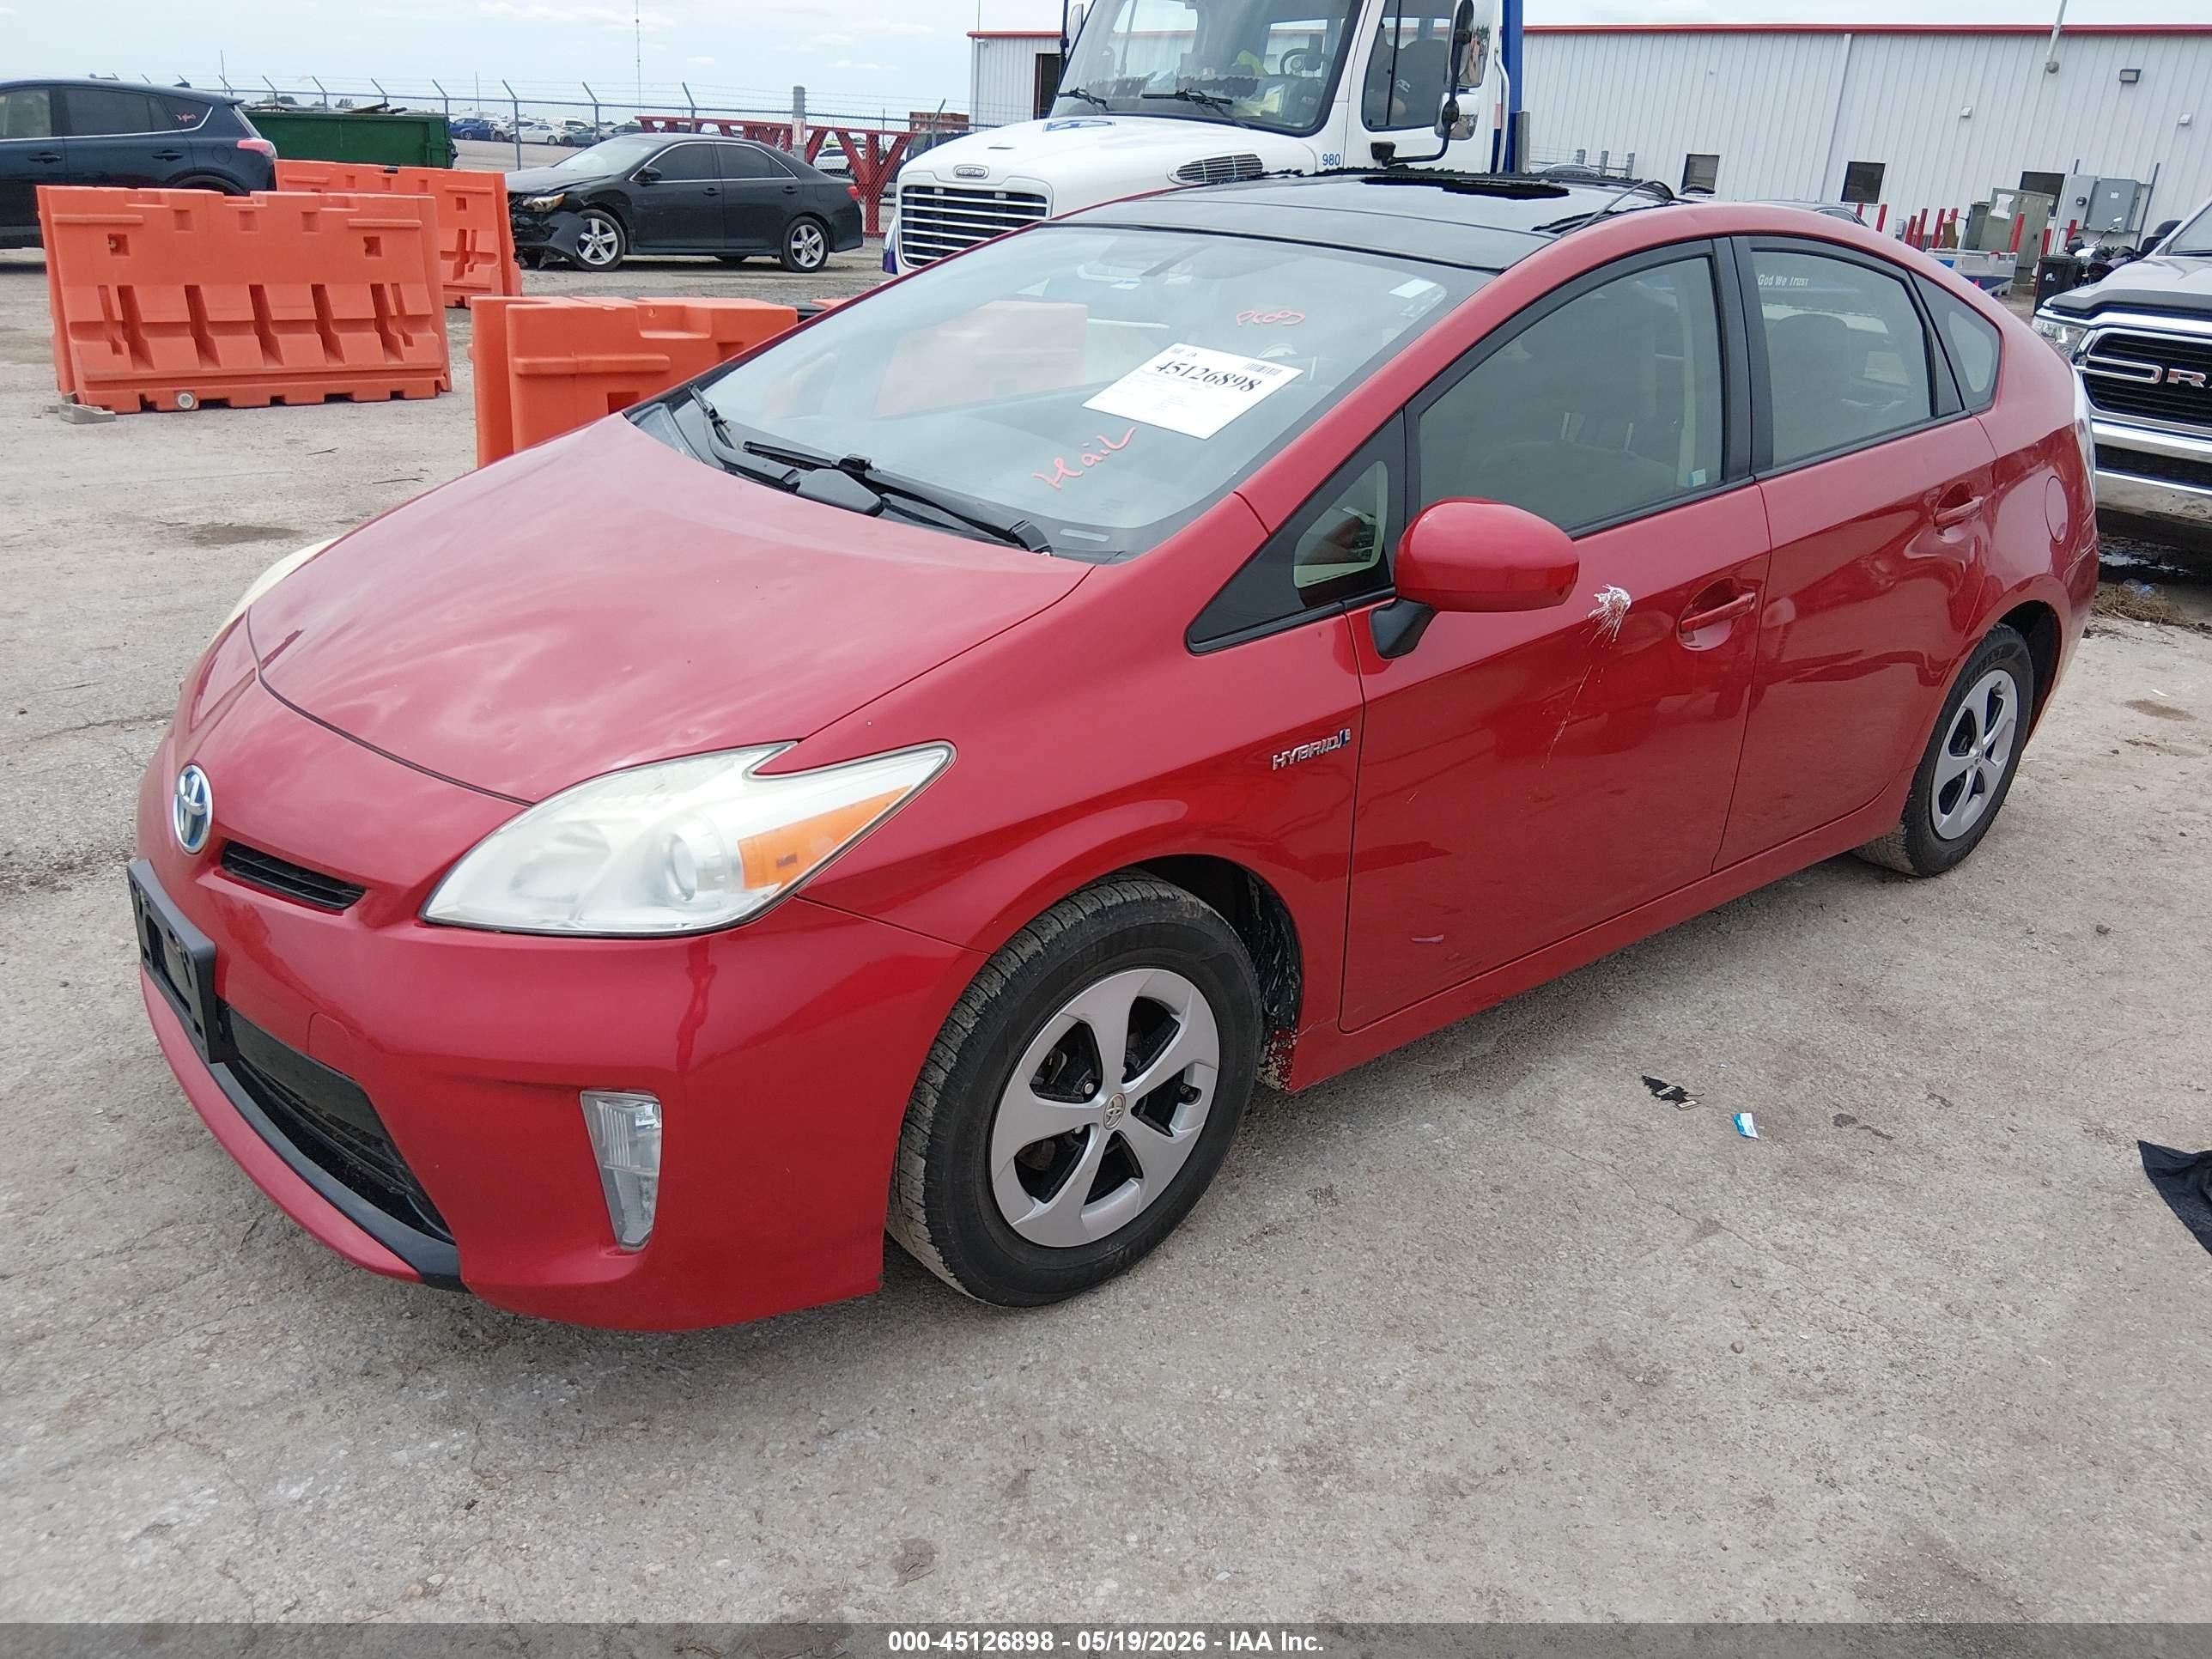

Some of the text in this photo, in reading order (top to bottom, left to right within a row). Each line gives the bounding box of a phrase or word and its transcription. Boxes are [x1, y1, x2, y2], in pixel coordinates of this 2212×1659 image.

[1322, 154, 1340, 166] 980
[1758, 274, 1774, 286] God
[1775, 275, 1787, 286] We
[1156, 361, 1262, 392] 45126898
[1273, 735, 1340, 771] HYBRID
